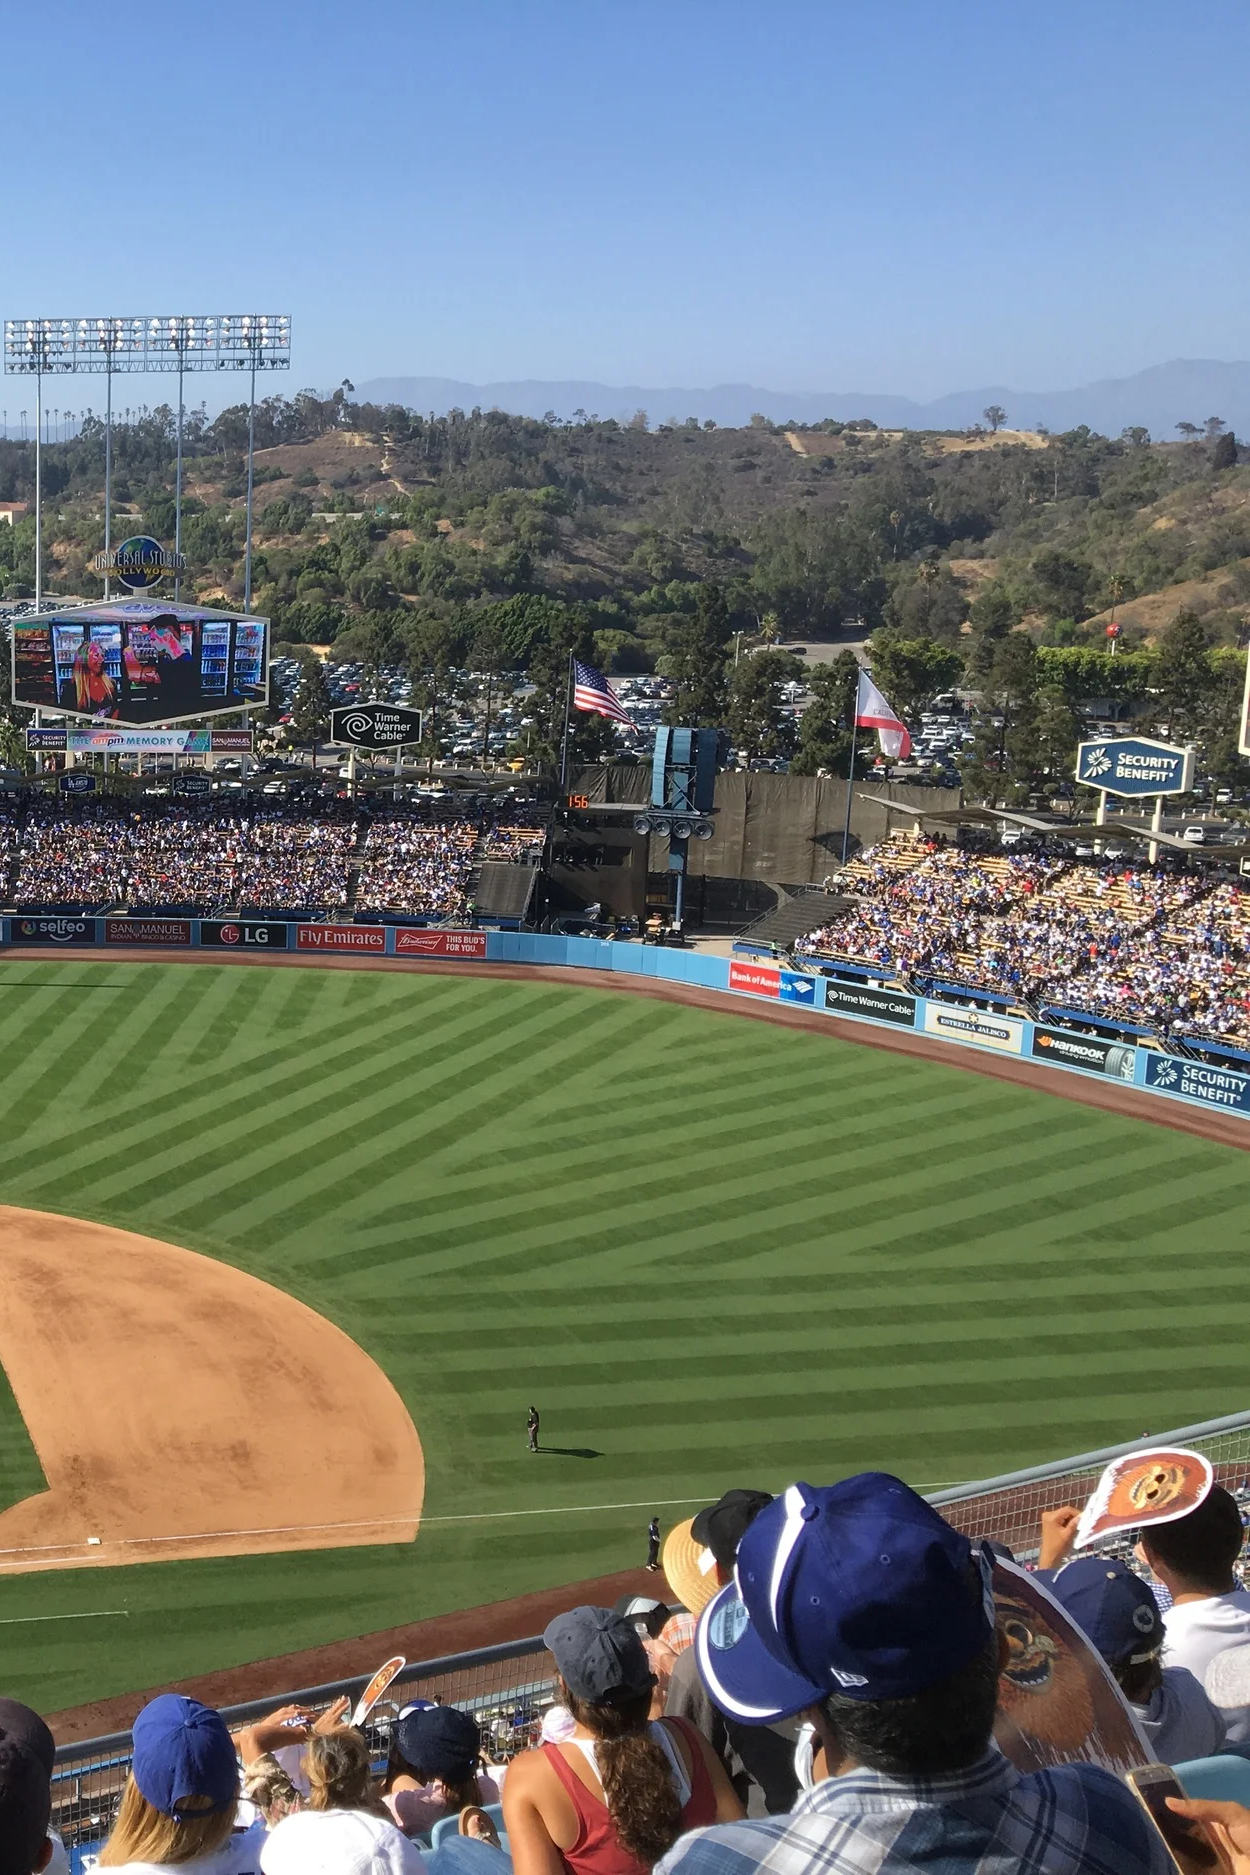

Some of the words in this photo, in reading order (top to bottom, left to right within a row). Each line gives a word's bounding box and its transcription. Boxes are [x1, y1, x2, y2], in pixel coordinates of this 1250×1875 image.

[94, 550, 146, 570] UNIVERSAL
[150, 549, 187, 570] STUDIOS
[374, 712, 400, 722] Time
[374, 722, 411, 731] Warner
[126, 737, 173, 745] MEMORY
[177, 737, 209, 745] GAME
[373, 731, 403, 740] Cable
[1117, 753, 1179, 769] SECURITY
[110, 924, 132, 933] SAN
[141, 924, 185, 934] MANUEL
[244, 928, 268, 943] LG
[300, 930, 321, 945] Fly
[325, 930, 383, 945] Emirates
[402, 937, 439, 946] Budweiser
[446, 935, 462, 943] THIS
[463, 936, 485, 944] BUD'S
[461, 944, 478, 952] YOU.
[731, 971, 751, 982] Bank
[751, 975, 760, 983] of
[759, 977, 792, 992] America
[837, 991, 858, 1004] Time
[858, 996, 888, 1010] Warner
[888, 1002, 912, 1016] Cable
[940, 1017, 976, 1032] ESTRELLA
[977, 1025, 1007, 1039] JALISCO
[1059, 1050, 1079, 1060] driving
[1079, 1053, 1104, 1065] emotion
[1182, 1065, 1247, 1092] SECURITY
